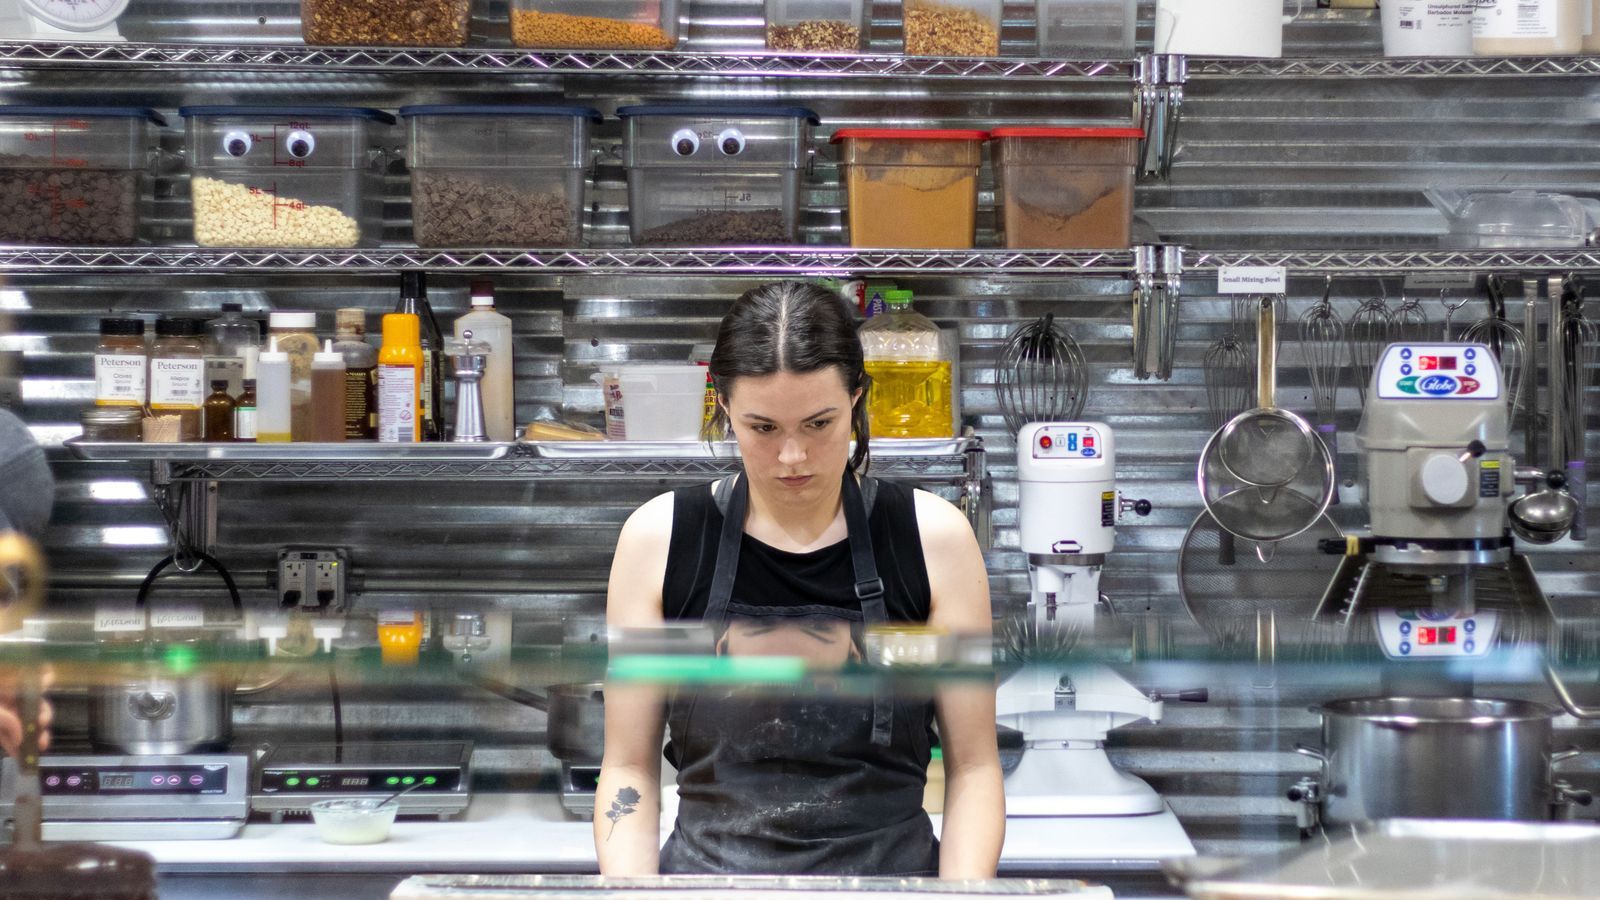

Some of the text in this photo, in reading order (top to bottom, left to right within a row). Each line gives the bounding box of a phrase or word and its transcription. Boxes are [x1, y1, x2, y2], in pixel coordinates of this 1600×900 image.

[101, 357, 141, 366] Peterson
[157, 361, 197, 370] Peterson
[1421, 377, 1455, 391] Globe
